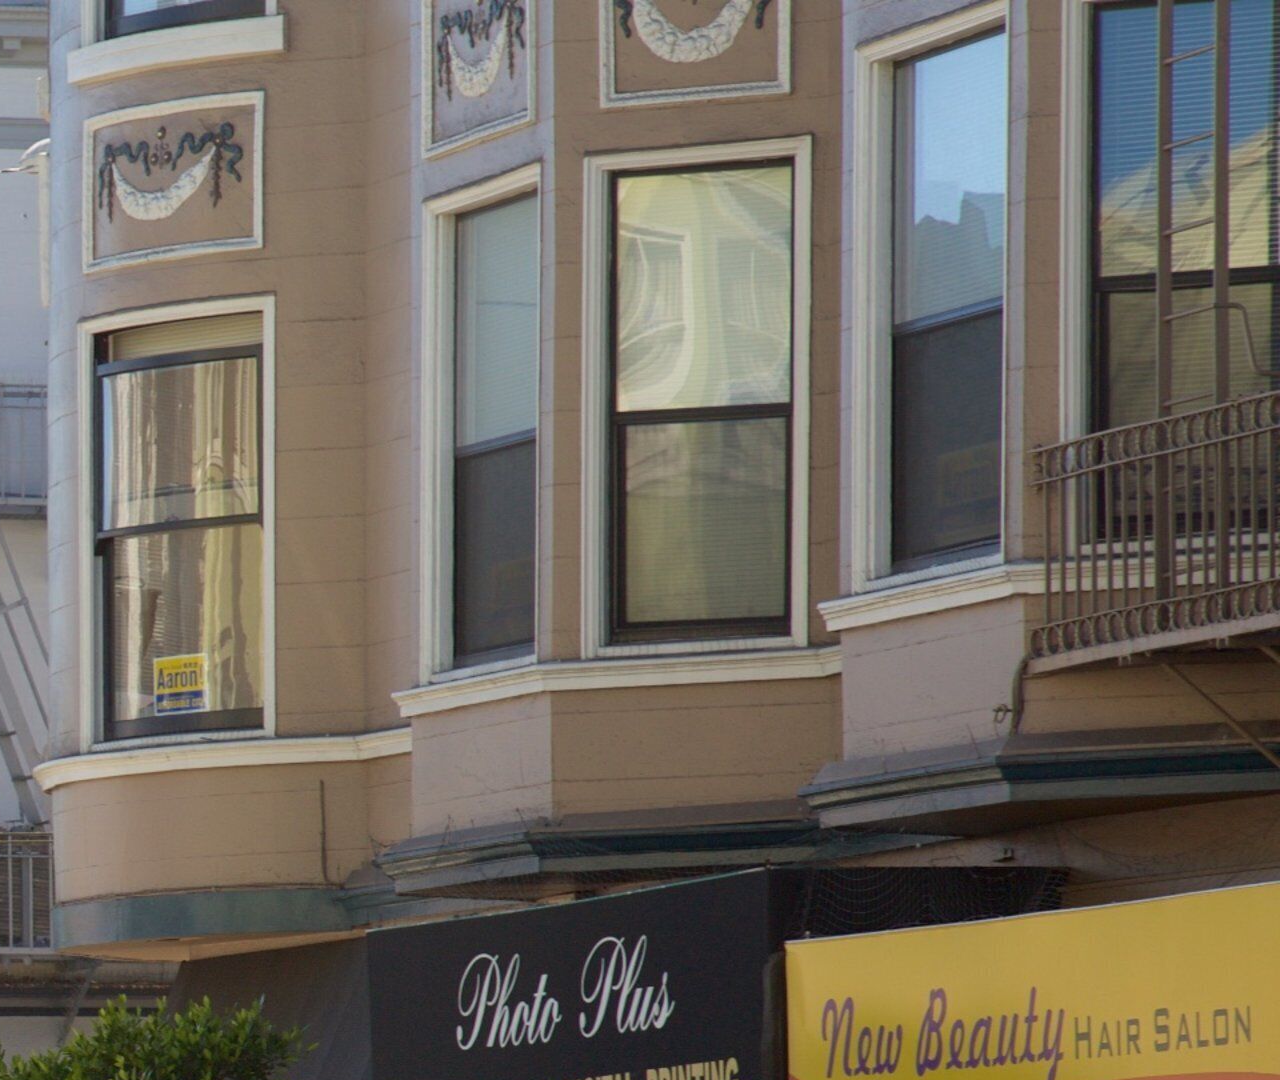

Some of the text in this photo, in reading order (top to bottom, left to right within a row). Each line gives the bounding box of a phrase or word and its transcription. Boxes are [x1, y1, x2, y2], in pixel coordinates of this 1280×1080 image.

[456, 935, 675, 1051] Photo Plus
[821, 997, 903, 1079] New
[1074, 1014, 1142, 1060] HAIR
[1153, 1005, 1253, 1053] SALON
